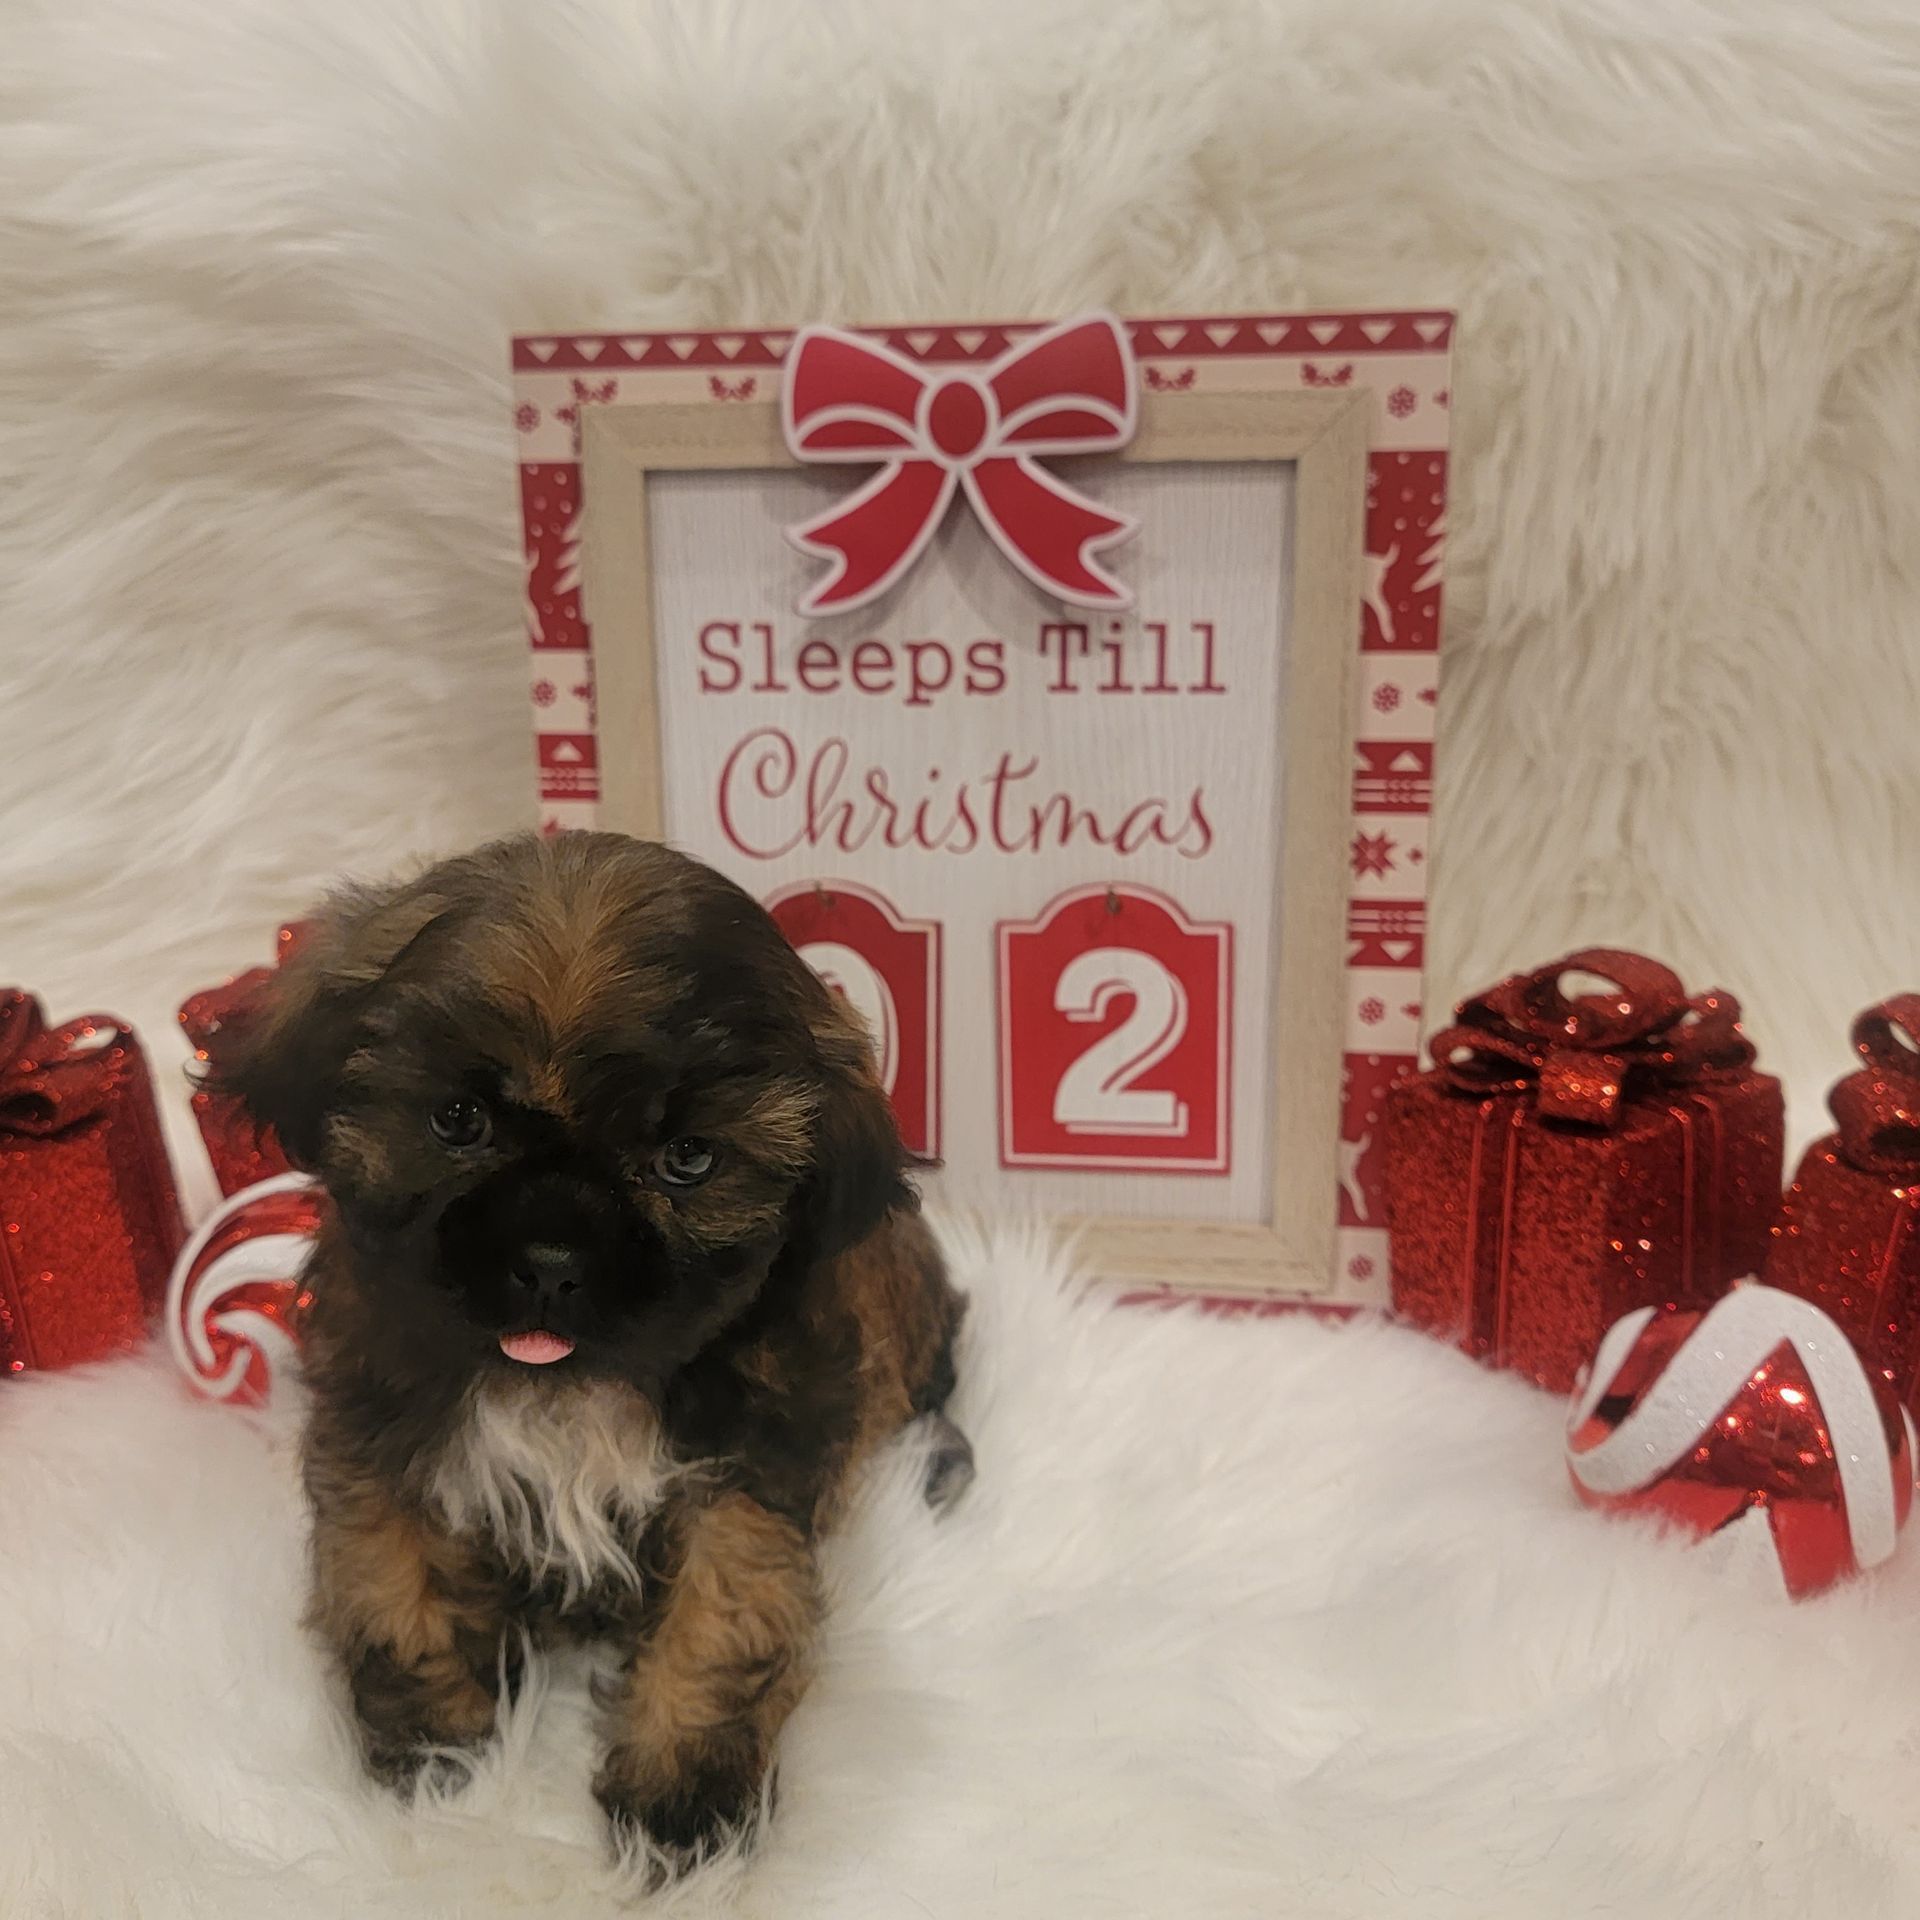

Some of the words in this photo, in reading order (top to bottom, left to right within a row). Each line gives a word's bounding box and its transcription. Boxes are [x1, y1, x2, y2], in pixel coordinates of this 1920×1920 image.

[699, 622, 1007, 705] Sleeps
[1039, 622, 1228, 694] Till
[717, 726, 1214, 860] Christmas
